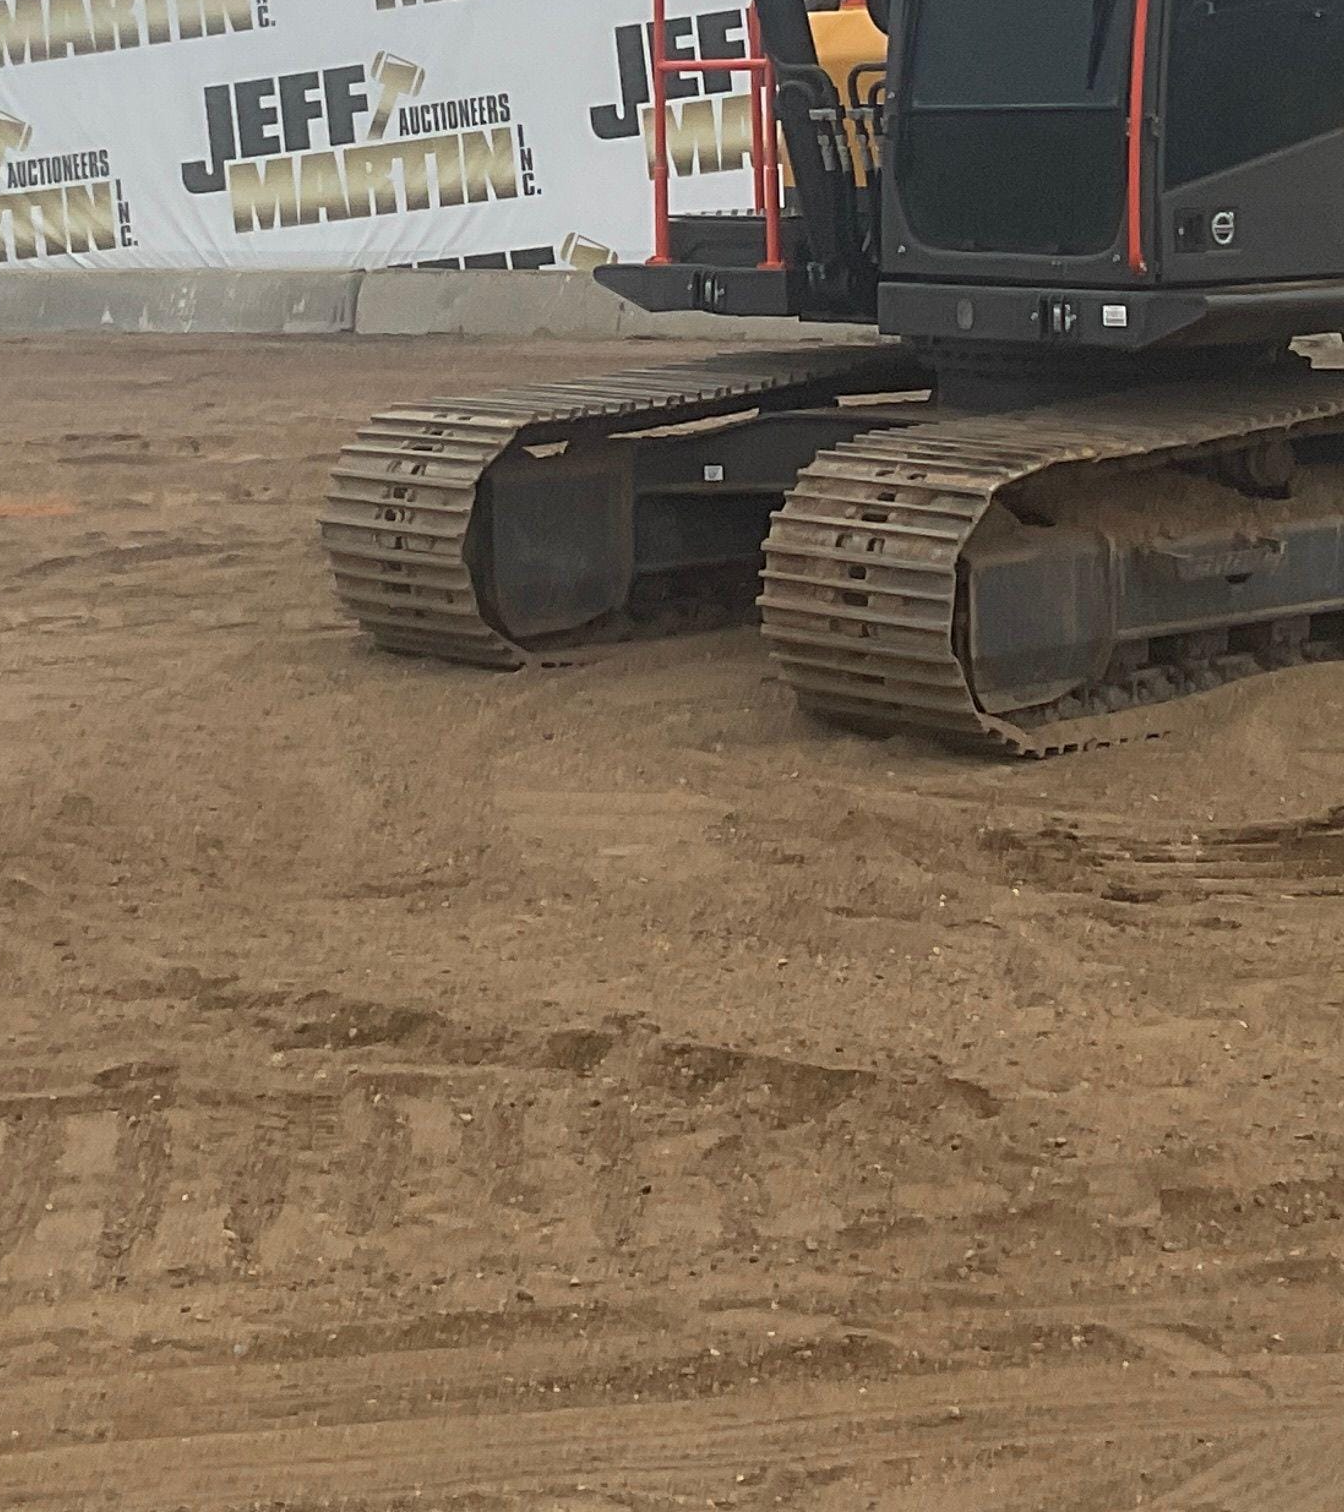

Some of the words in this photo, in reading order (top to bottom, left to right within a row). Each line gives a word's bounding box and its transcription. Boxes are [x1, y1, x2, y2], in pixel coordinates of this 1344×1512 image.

[181, 64, 369, 195] JEFF
[398, 92, 511, 137] AUCTIONEERS
[6, 148, 111, 190] AUCTIONEERS
[228, 126, 518, 234] MARTIN
